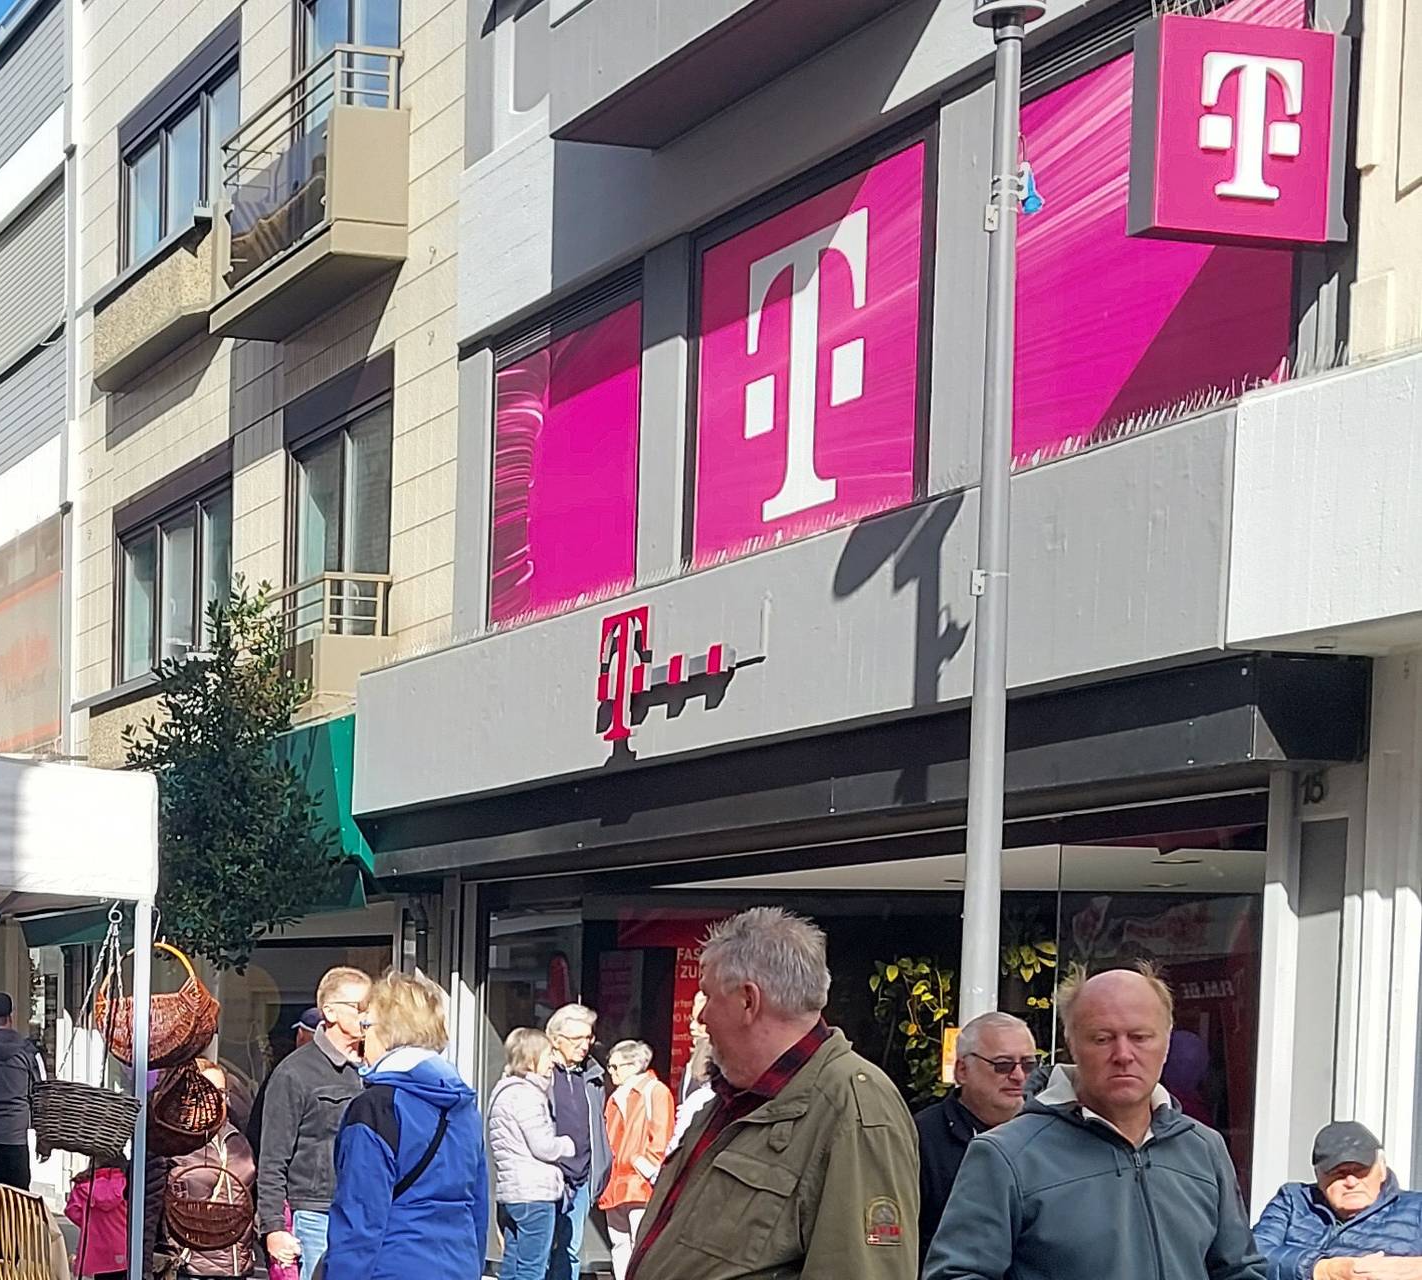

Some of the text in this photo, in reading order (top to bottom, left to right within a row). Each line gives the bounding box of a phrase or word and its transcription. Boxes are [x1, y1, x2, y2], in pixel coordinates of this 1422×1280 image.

[1198, 50, 1303, 202] T
[744, 207, 869, 522] T
[679, 965, 701, 979] ZU
